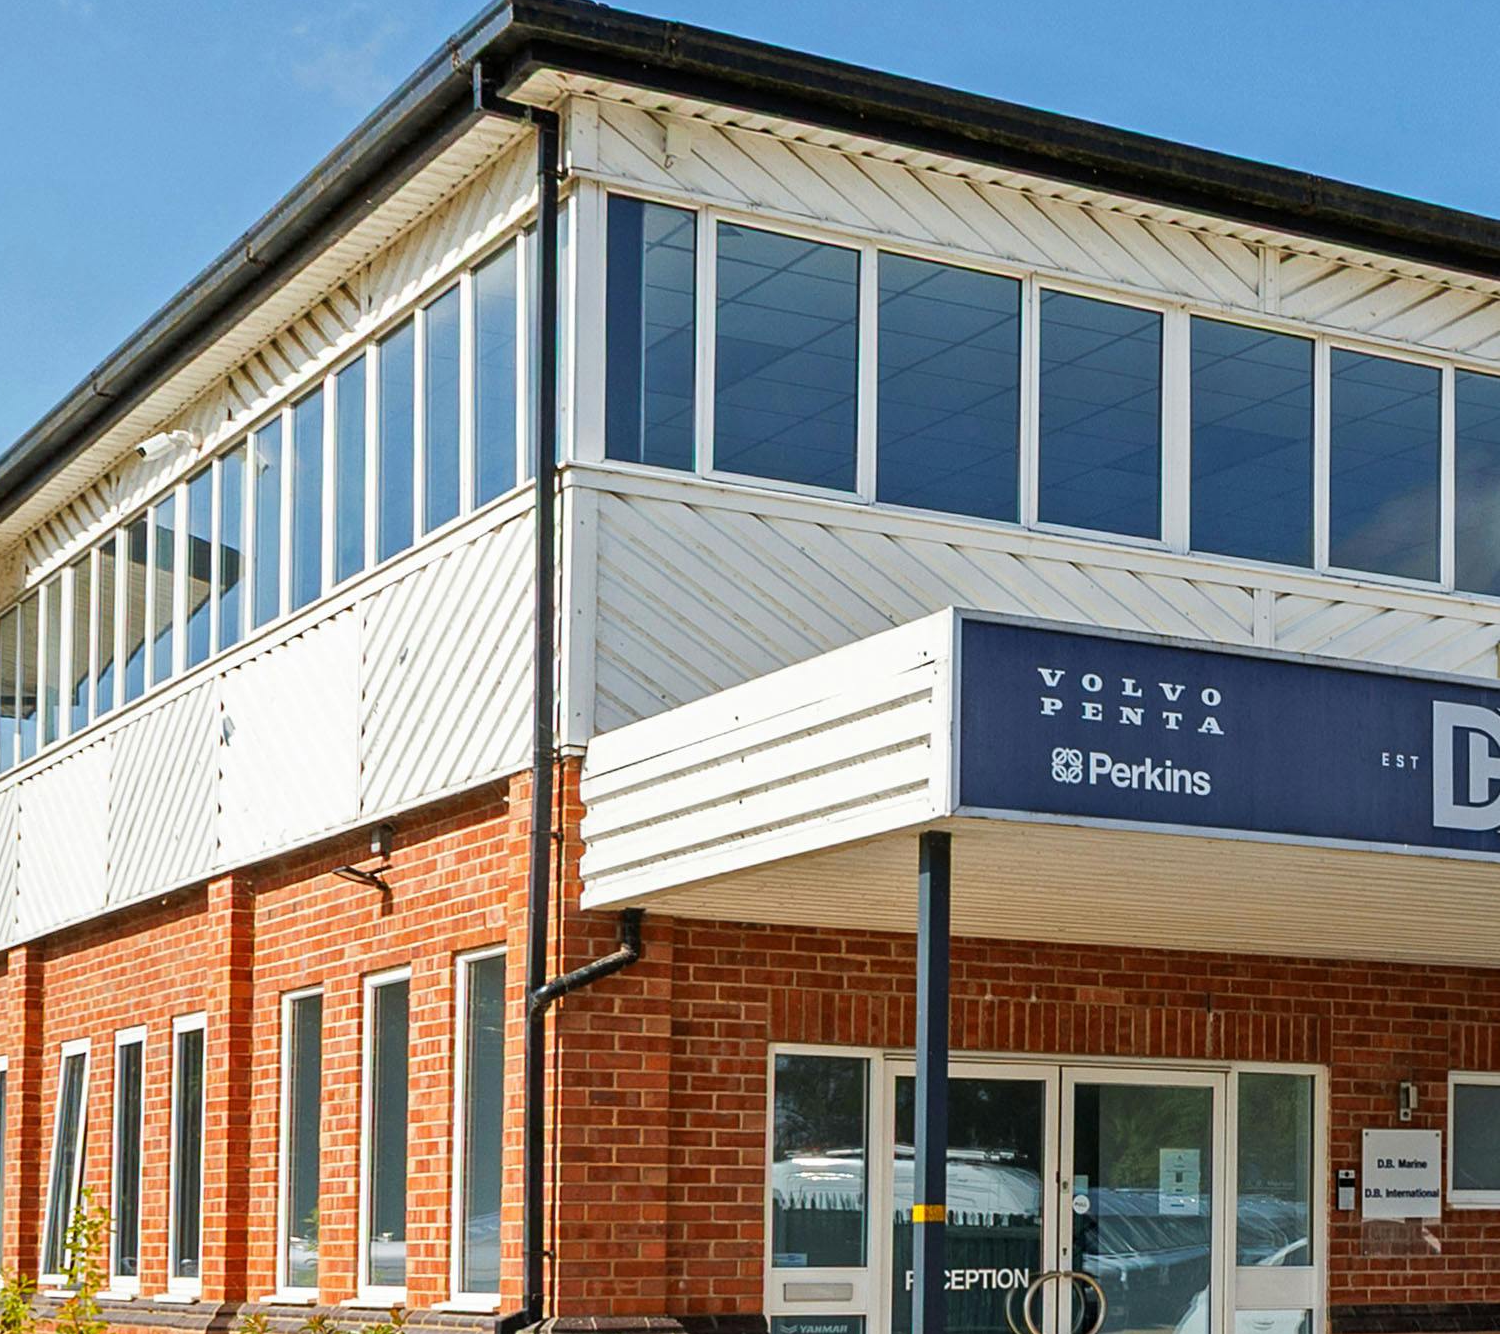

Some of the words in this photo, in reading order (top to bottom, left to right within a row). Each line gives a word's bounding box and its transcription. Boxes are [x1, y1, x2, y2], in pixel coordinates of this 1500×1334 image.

[1037, 667, 1222, 707] VOLVO
[1040, 696, 1225, 736] PENTA
[1382, 752, 1420, 769] EST
[1089, 751, 1211, 796] Perkins
[1398, 1157, 1428, 1169] Marine
[1386, 1187, 1439, 1198] International
[905, 1268, 1029, 1291] REPTION
[800, 1325, 848, 1334] YANMAR
